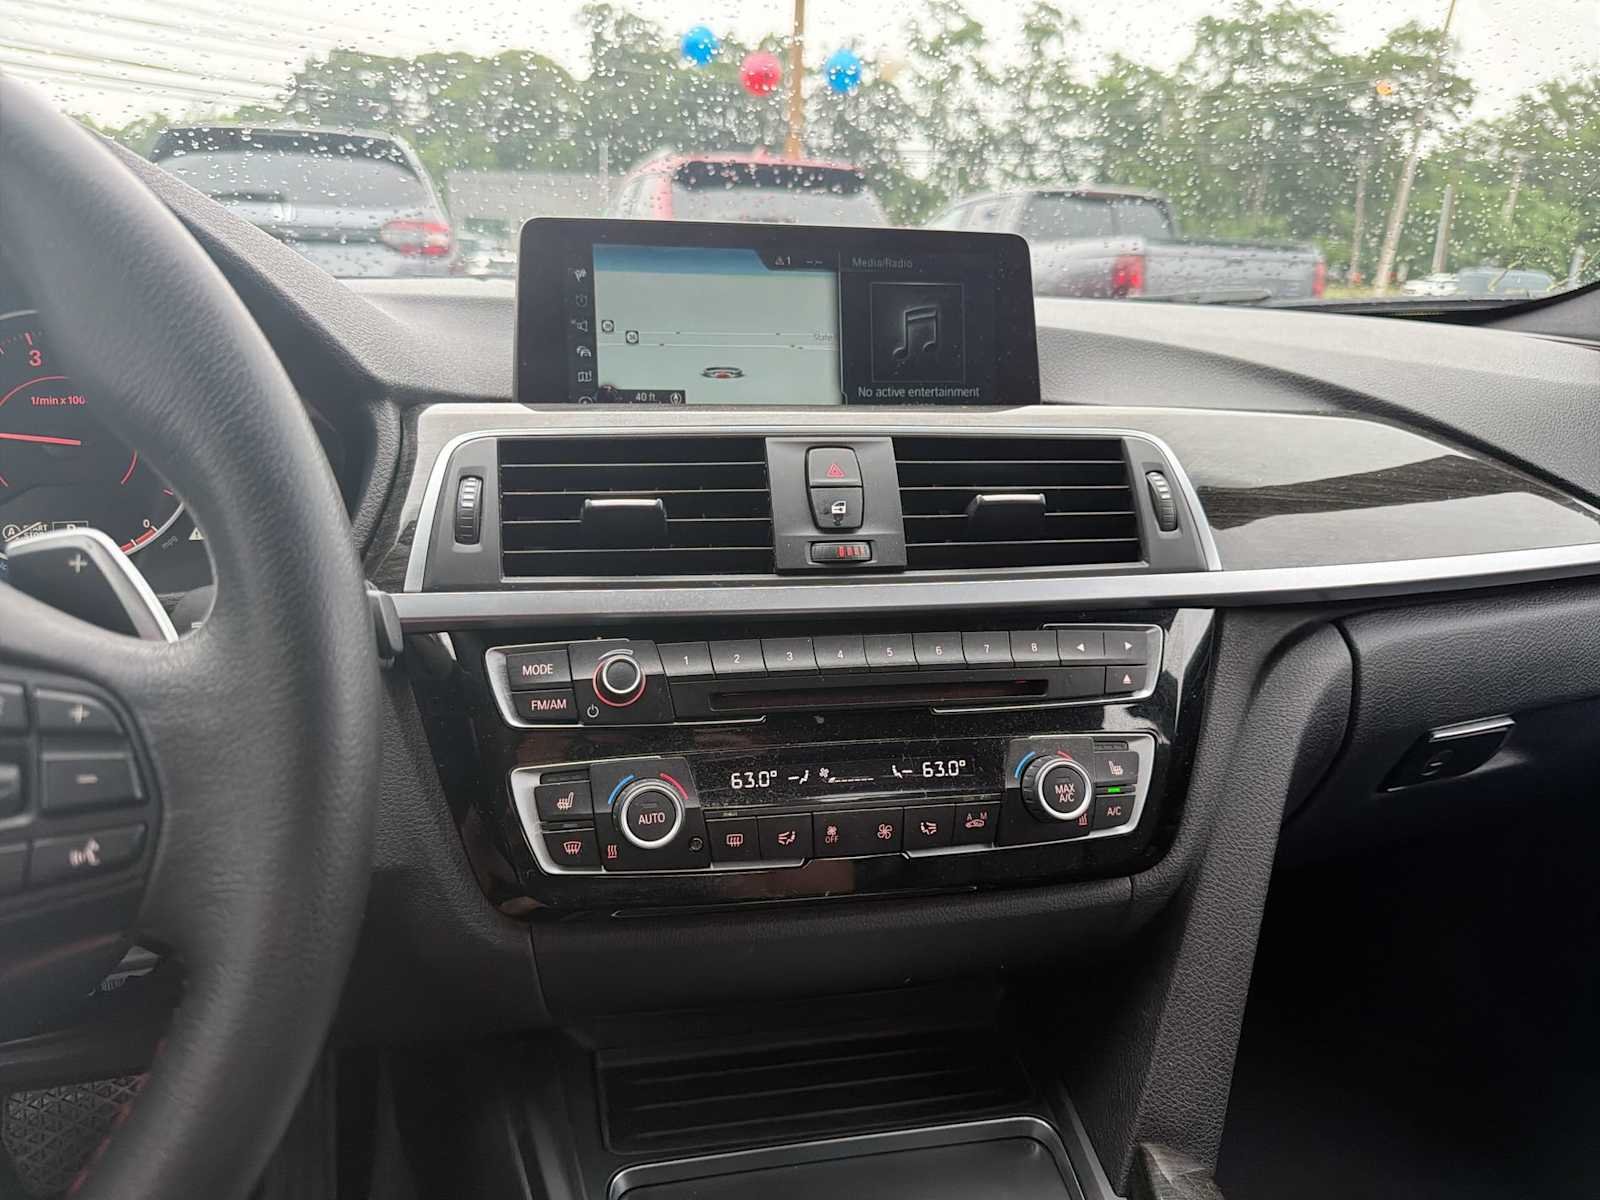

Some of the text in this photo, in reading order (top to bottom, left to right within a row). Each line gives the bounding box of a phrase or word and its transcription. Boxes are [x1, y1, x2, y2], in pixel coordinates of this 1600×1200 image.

[851, 257, 913, 269] Media/Radio
[29, 350, 42, 367] 3
[635, 391, 648, 402] 40
[858, 386, 980, 397] No active entertainment
[143, 519, 151, 529] 0
[886, 647, 893, 657] 5
[935, 646, 943, 656] 6
[983, 644, 990, 654] 7
[1031, 642, 1038, 652] 8
[733, 653, 741, 664] 2
[785, 651, 793, 661] 3
[836, 649, 844, 659] 4
[683, 655, 689, 665] 1
[522, 663, 554, 676] MODE
[531, 698, 567, 711] FM/AM
[1055, 783, 1076, 795] MAX
[1059, 792, 1075, 803] A/C
[1107, 806, 1121, 816] A/C
[638, 811, 666, 825] AUTO
[825, 835, 839, 844] OFF
